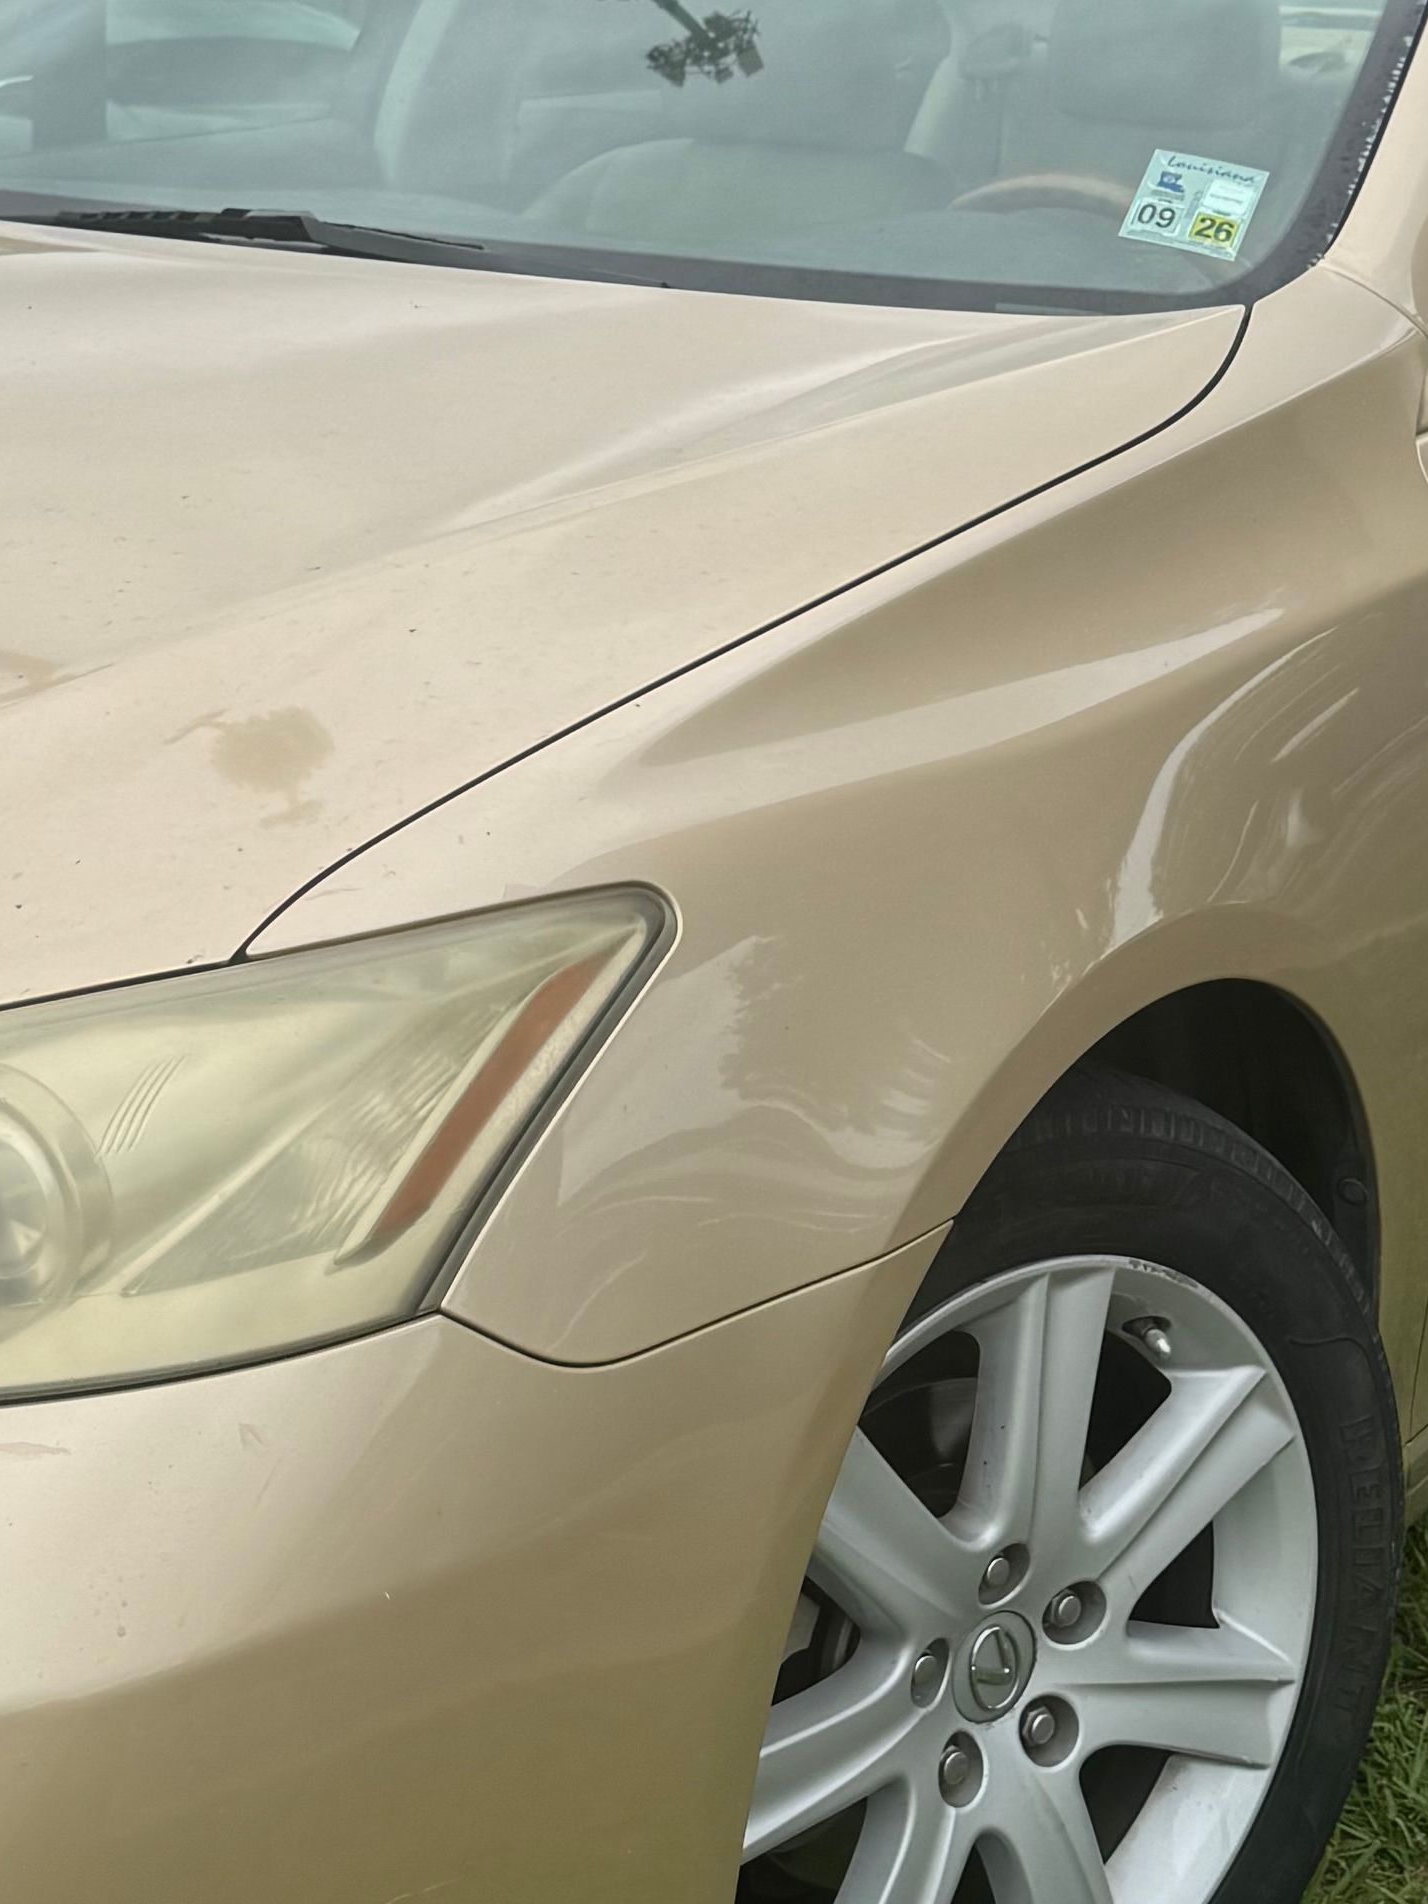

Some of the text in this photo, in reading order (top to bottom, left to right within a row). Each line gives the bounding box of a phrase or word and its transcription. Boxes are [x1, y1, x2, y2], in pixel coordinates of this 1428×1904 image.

[1166, 155, 1255, 184] Louisiana
[1137, 203, 1235, 243] 09 26
